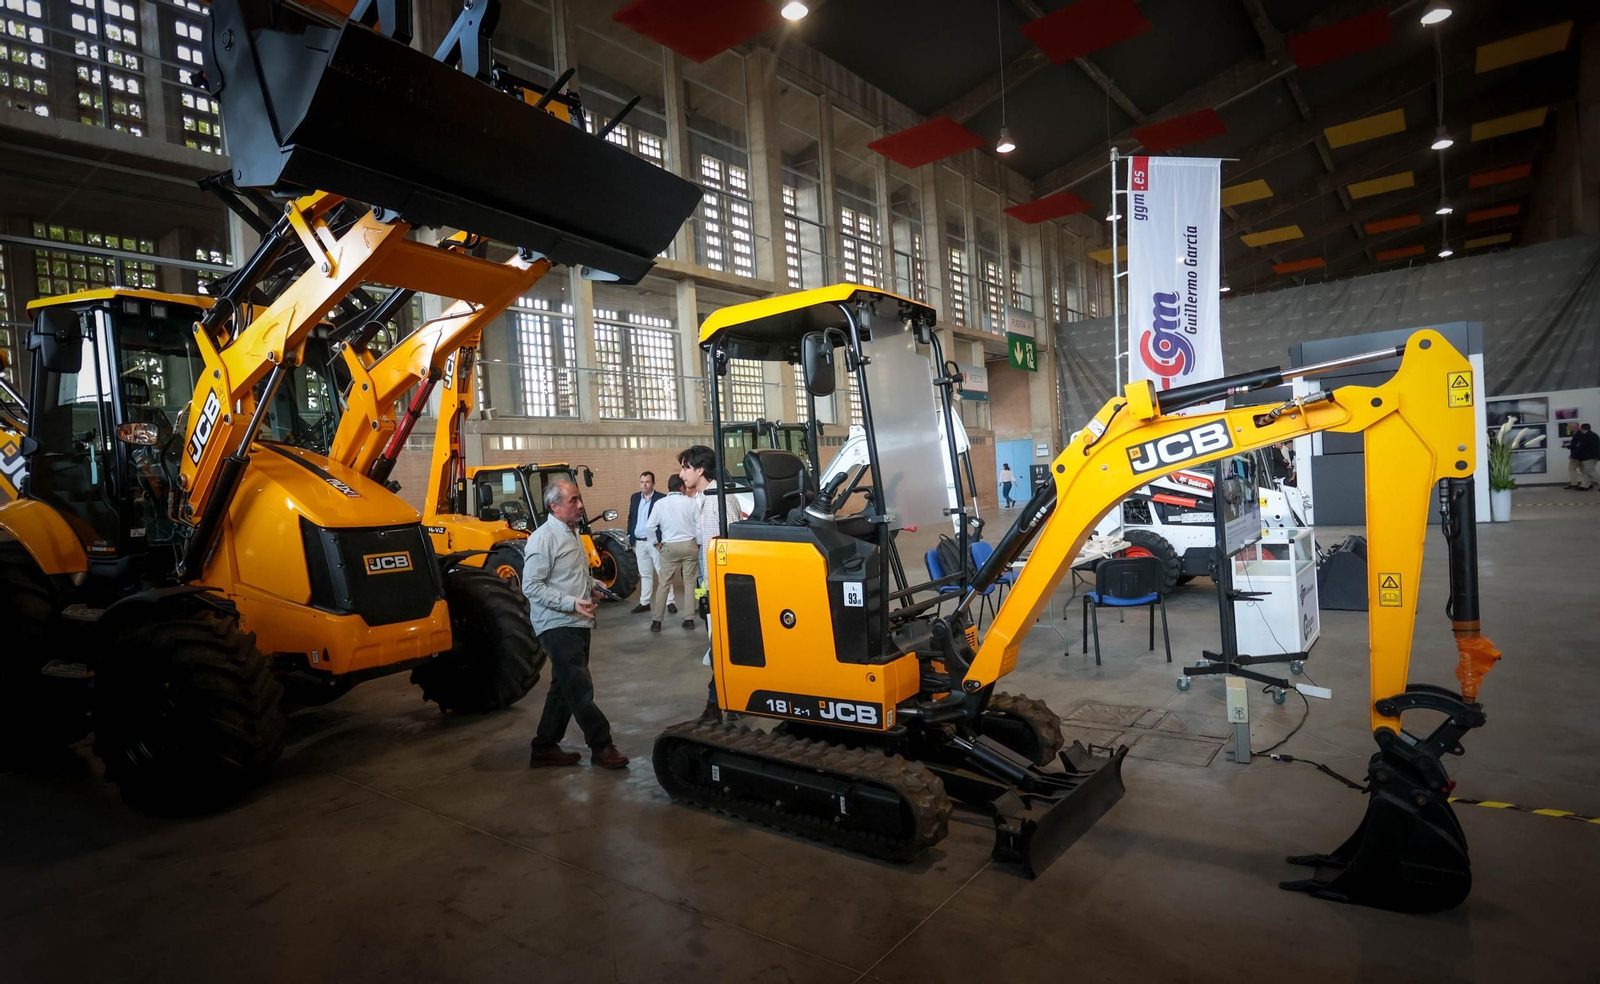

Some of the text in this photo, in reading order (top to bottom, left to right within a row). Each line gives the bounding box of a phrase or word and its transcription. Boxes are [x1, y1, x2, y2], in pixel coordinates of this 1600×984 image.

[1134, 170, 1148, 222] ggm.es
[1183, 225, 1198, 335] Guillermo García
[969, 373, 984, 384] ASEOS
[192, 391, 221, 464] JCB
[1131, 422, 1229, 472] JCB
[1187, 478, 1208, 489] Bobcat
[369, 554, 409, 571] JCB
[848, 592, 858, 605] 93
[766, 698, 788, 714] 18
[819, 701, 879, 726] JCB
